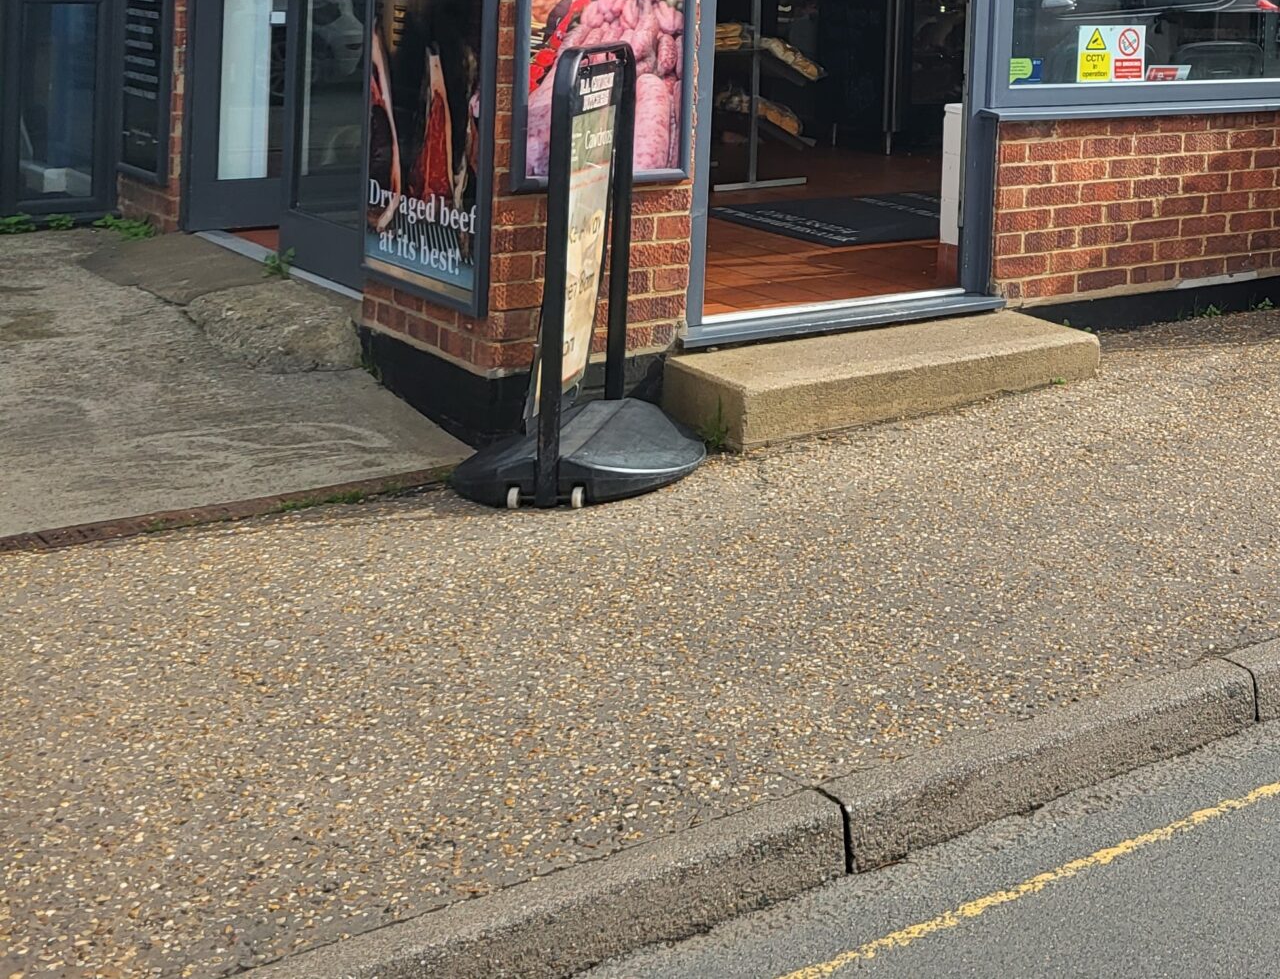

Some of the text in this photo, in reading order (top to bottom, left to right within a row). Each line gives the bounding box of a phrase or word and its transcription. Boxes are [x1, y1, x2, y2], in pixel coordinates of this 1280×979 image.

[1086, 54, 1105, 63] CCTV
[1082, 70, 1108, 78] operation
[369, 179, 476, 234] Dry aged beef
[379, 228, 460, 275] at its best!
